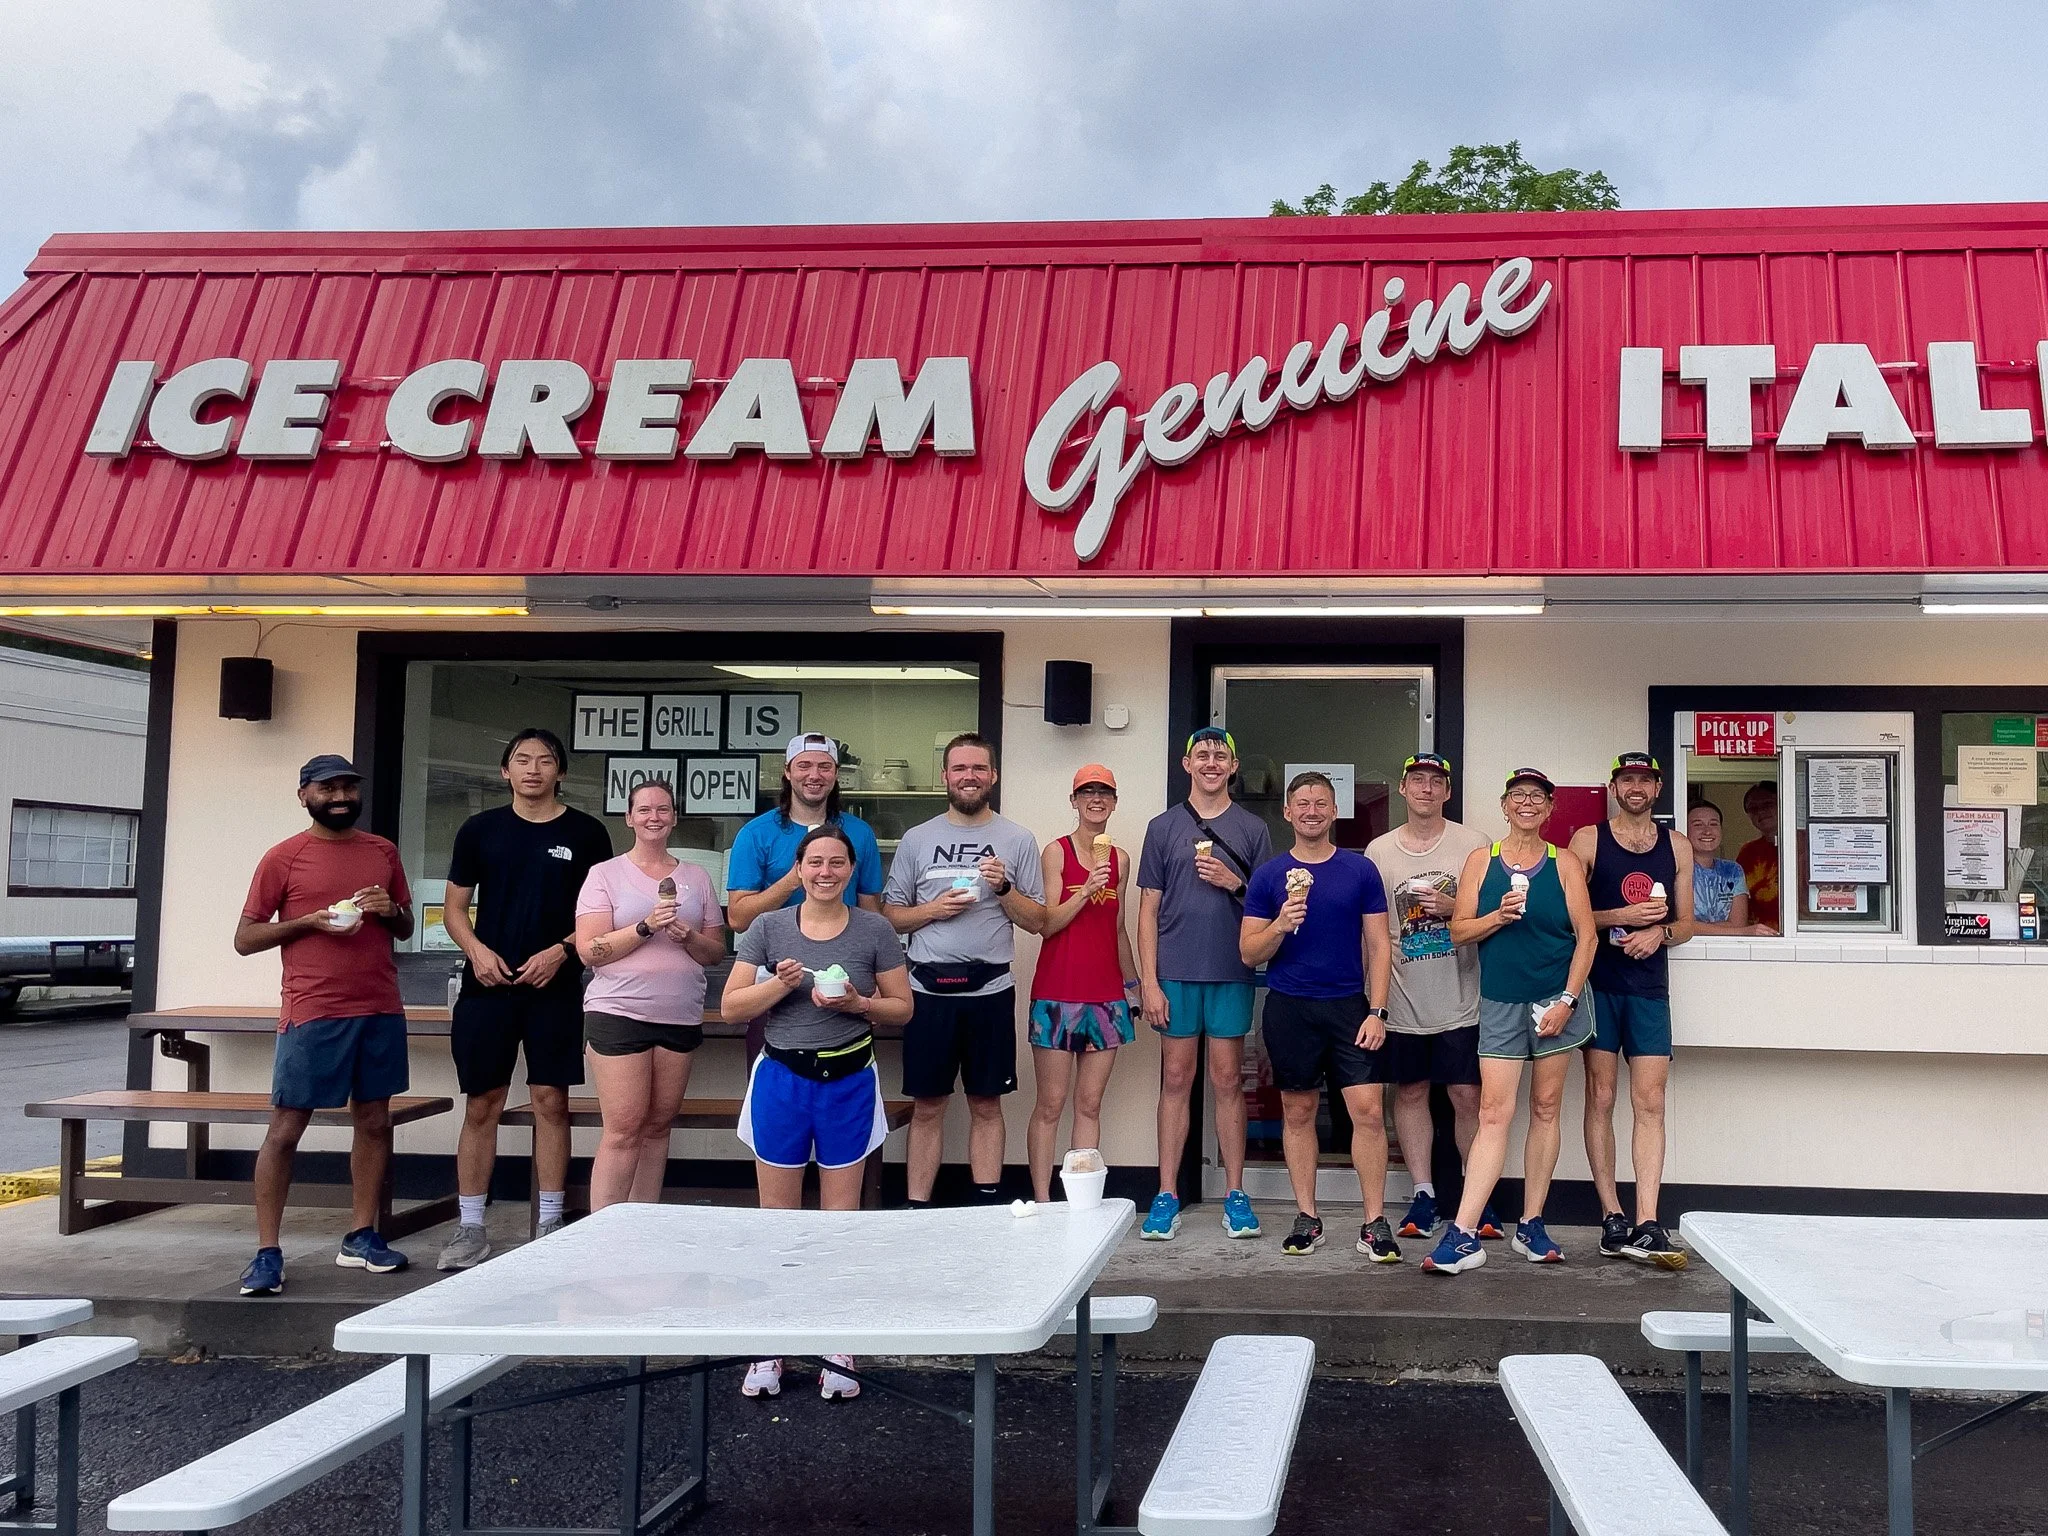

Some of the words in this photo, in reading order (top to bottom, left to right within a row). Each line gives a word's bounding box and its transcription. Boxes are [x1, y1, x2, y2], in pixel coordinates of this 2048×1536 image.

[84, 358, 341, 460] ICE
[386, 357, 976, 462] CREAM
[1024, 257, 1552, 562] Genuine
[1620, 340, 2048, 454] ITAL
[580, 707, 639, 737] THE
[655, 706, 715, 736] GRILL
[745, 705, 780, 736] IS
[1701, 720, 1769, 737] PICK-UP
[1714, 739, 1756, 754] HERE
[690, 770, 750, 800] OPEN
[933, 843, 997, 864] NFA
[1629, 881, 1648, 889] RUN
[1960, 926, 1988, 935] Lovers
